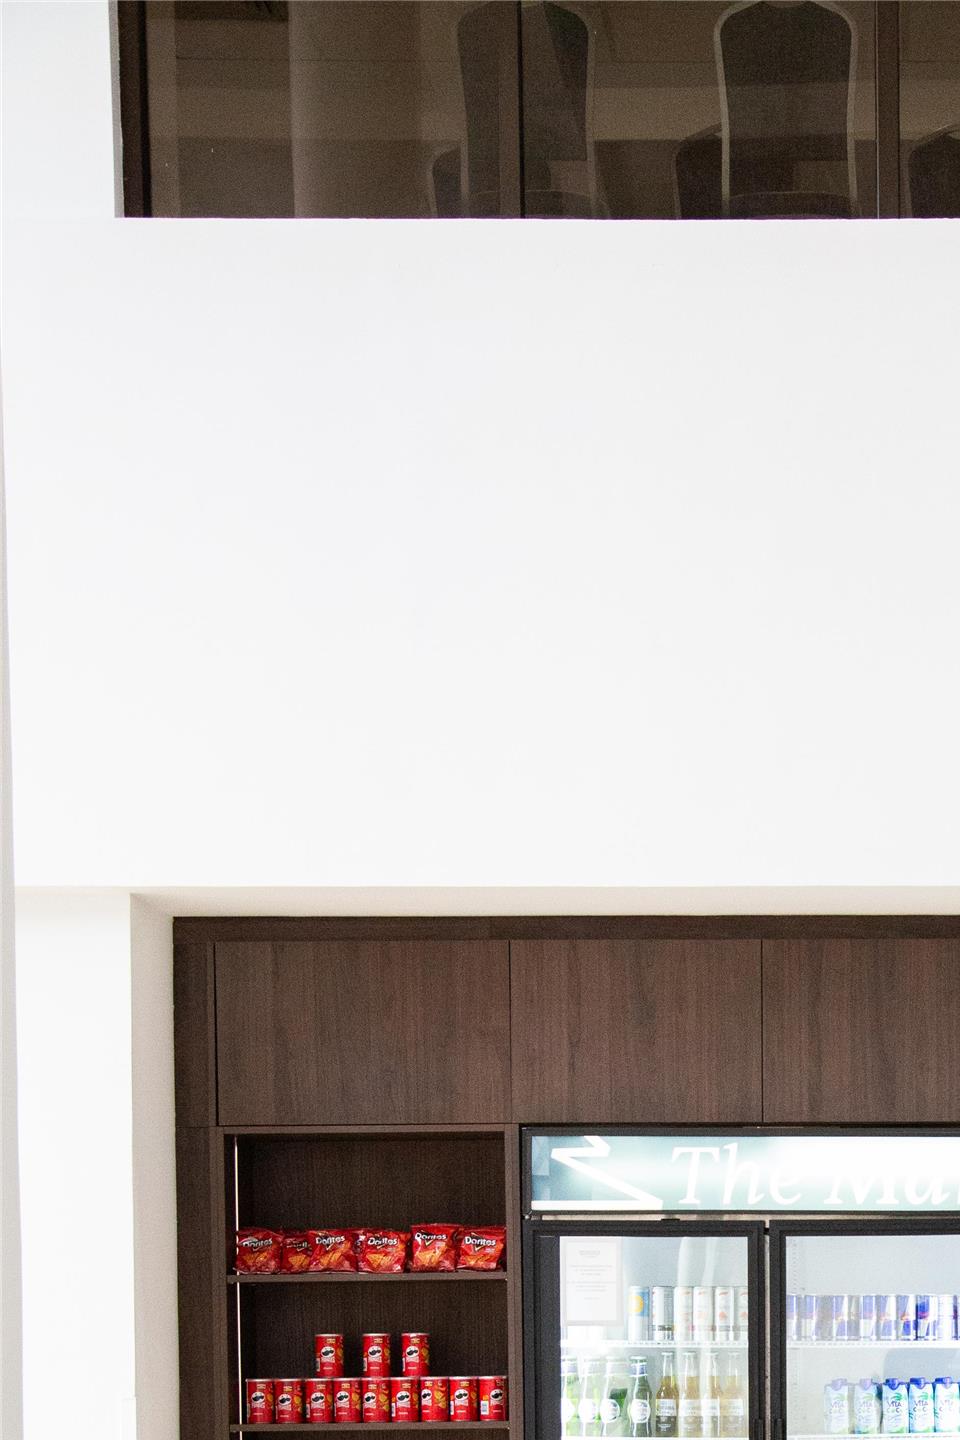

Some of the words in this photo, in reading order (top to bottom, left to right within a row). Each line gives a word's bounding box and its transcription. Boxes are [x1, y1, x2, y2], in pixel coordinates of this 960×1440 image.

[671, 1142, 802, 1207] The
[315, 1236, 346, 1246] Doritos
[367, 1237, 398, 1246] Doritos
[414, 1232, 447, 1242] Doritos
[464, 1236, 496, 1246] Doritos
